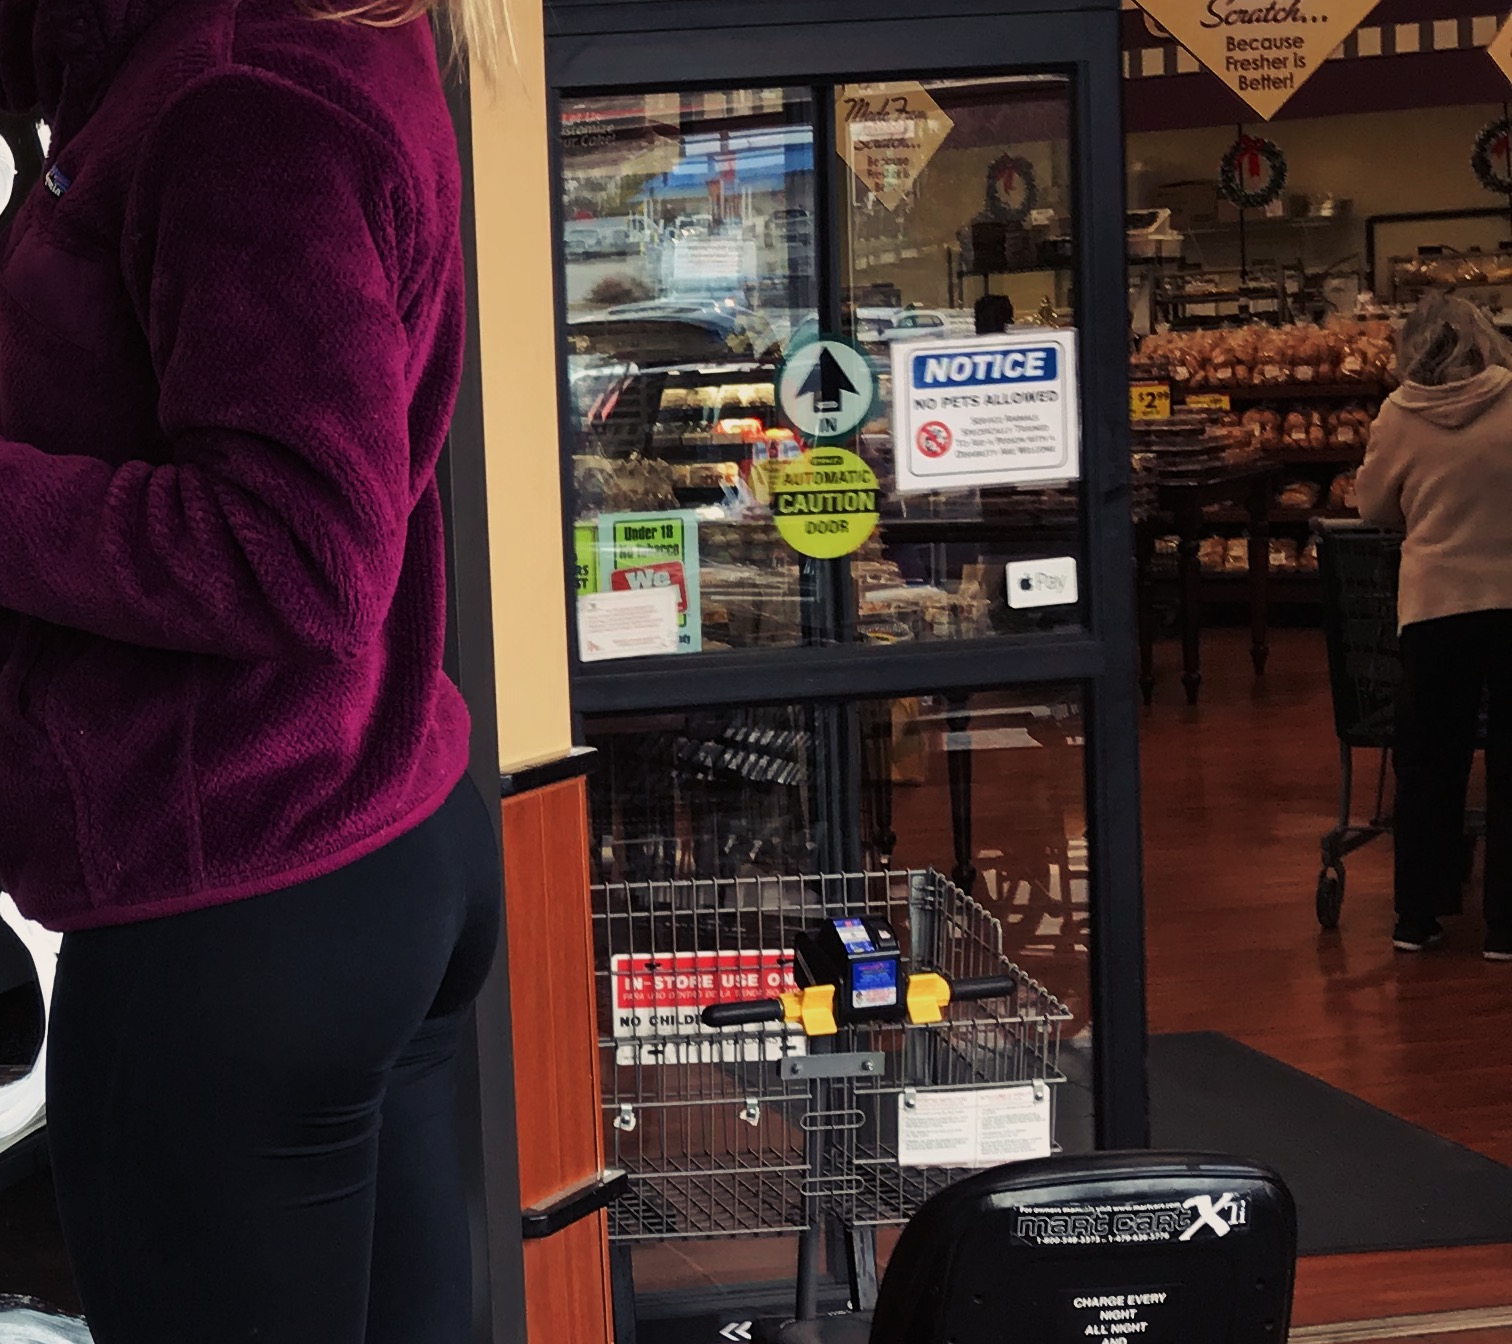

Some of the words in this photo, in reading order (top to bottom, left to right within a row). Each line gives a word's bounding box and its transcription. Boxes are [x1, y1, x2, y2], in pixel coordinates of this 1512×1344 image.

[1226, 35, 1305, 53] Because
[1226, 55, 1290, 72] Fresher
[1293, 52, 1307, 69] is
[1239, 72, 1294, 91] Better!
[924, 352, 1047, 383] NOTICE
[914, 398, 937, 410] NO
[941, 395, 980, 408] PETS
[984, 390, 1059, 406] ALLOWED
[819, 417, 838, 432] IN
[785, 471, 871, 485] AUTOMATIC
[779, 491, 876, 513] CAUTION
[624, 526, 657, 541] Under
[661, 524, 674, 539] 18
[805, 519, 849, 535] DOOR
[1034, 572, 1068, 594] Pay
[624, 975, 714, 991] IN-STORE
[722, 973, 759, 988] USE
[620, 1017, 641, 1028] NO
[1073, 1296, 1125, 1309] CHARGE
[1127, 1292, 1167, 1306] EVERY
[1099, 1308, 1138, 1321] NIGHT
[1084, 1324, 1108, 1336] ALL
[1110, 1321, 1148, 1334] NIGHT
